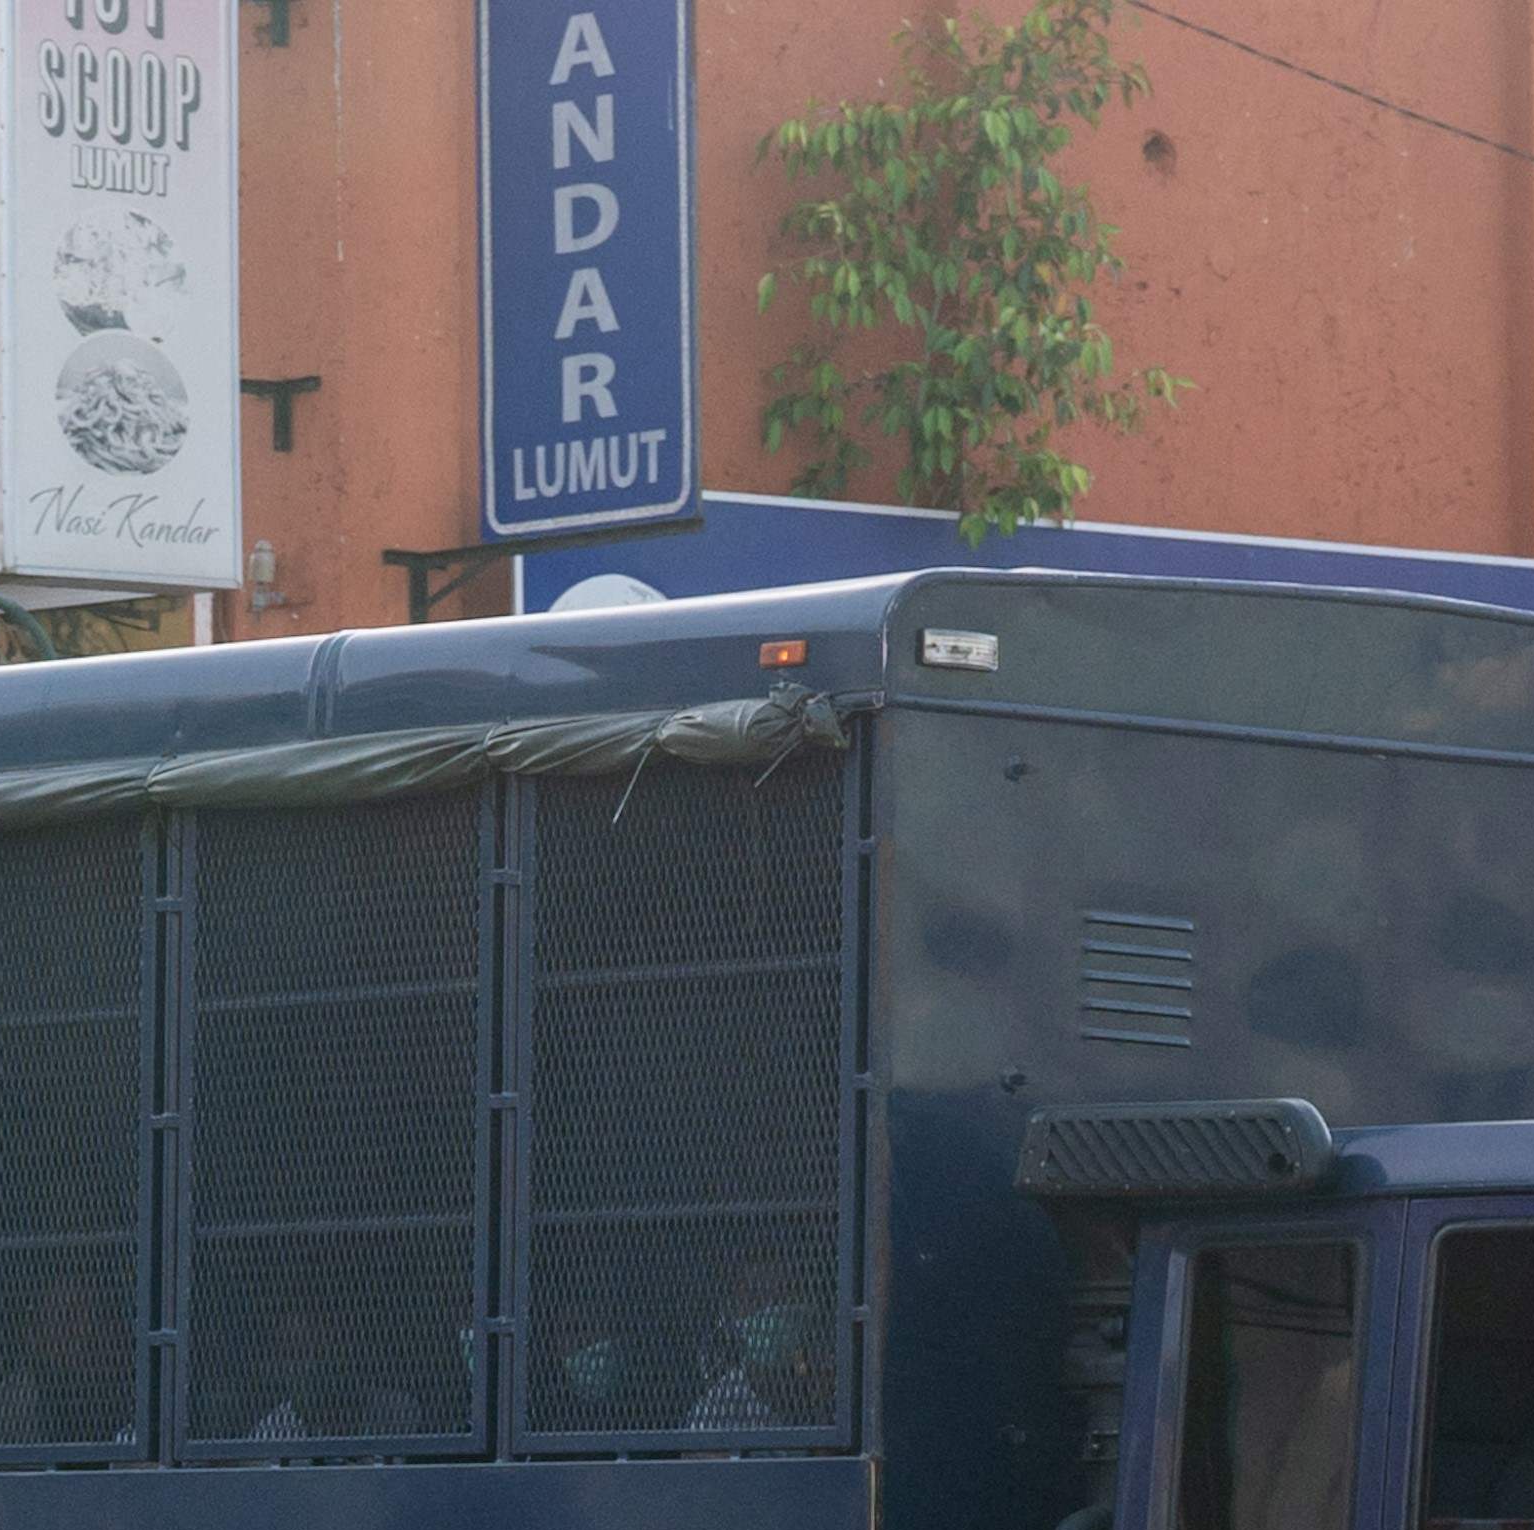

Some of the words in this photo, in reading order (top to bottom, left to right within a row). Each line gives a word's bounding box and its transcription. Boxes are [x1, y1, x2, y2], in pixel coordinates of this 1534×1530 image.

[38, 38, 201, 152] SCOOP
[71, 144, 171, 198] LUMUT
[513, 428, 667, 501] LUMUT
[29, 484, 106, 535] Nasi
[108, 493, 220, 549] Kandar
